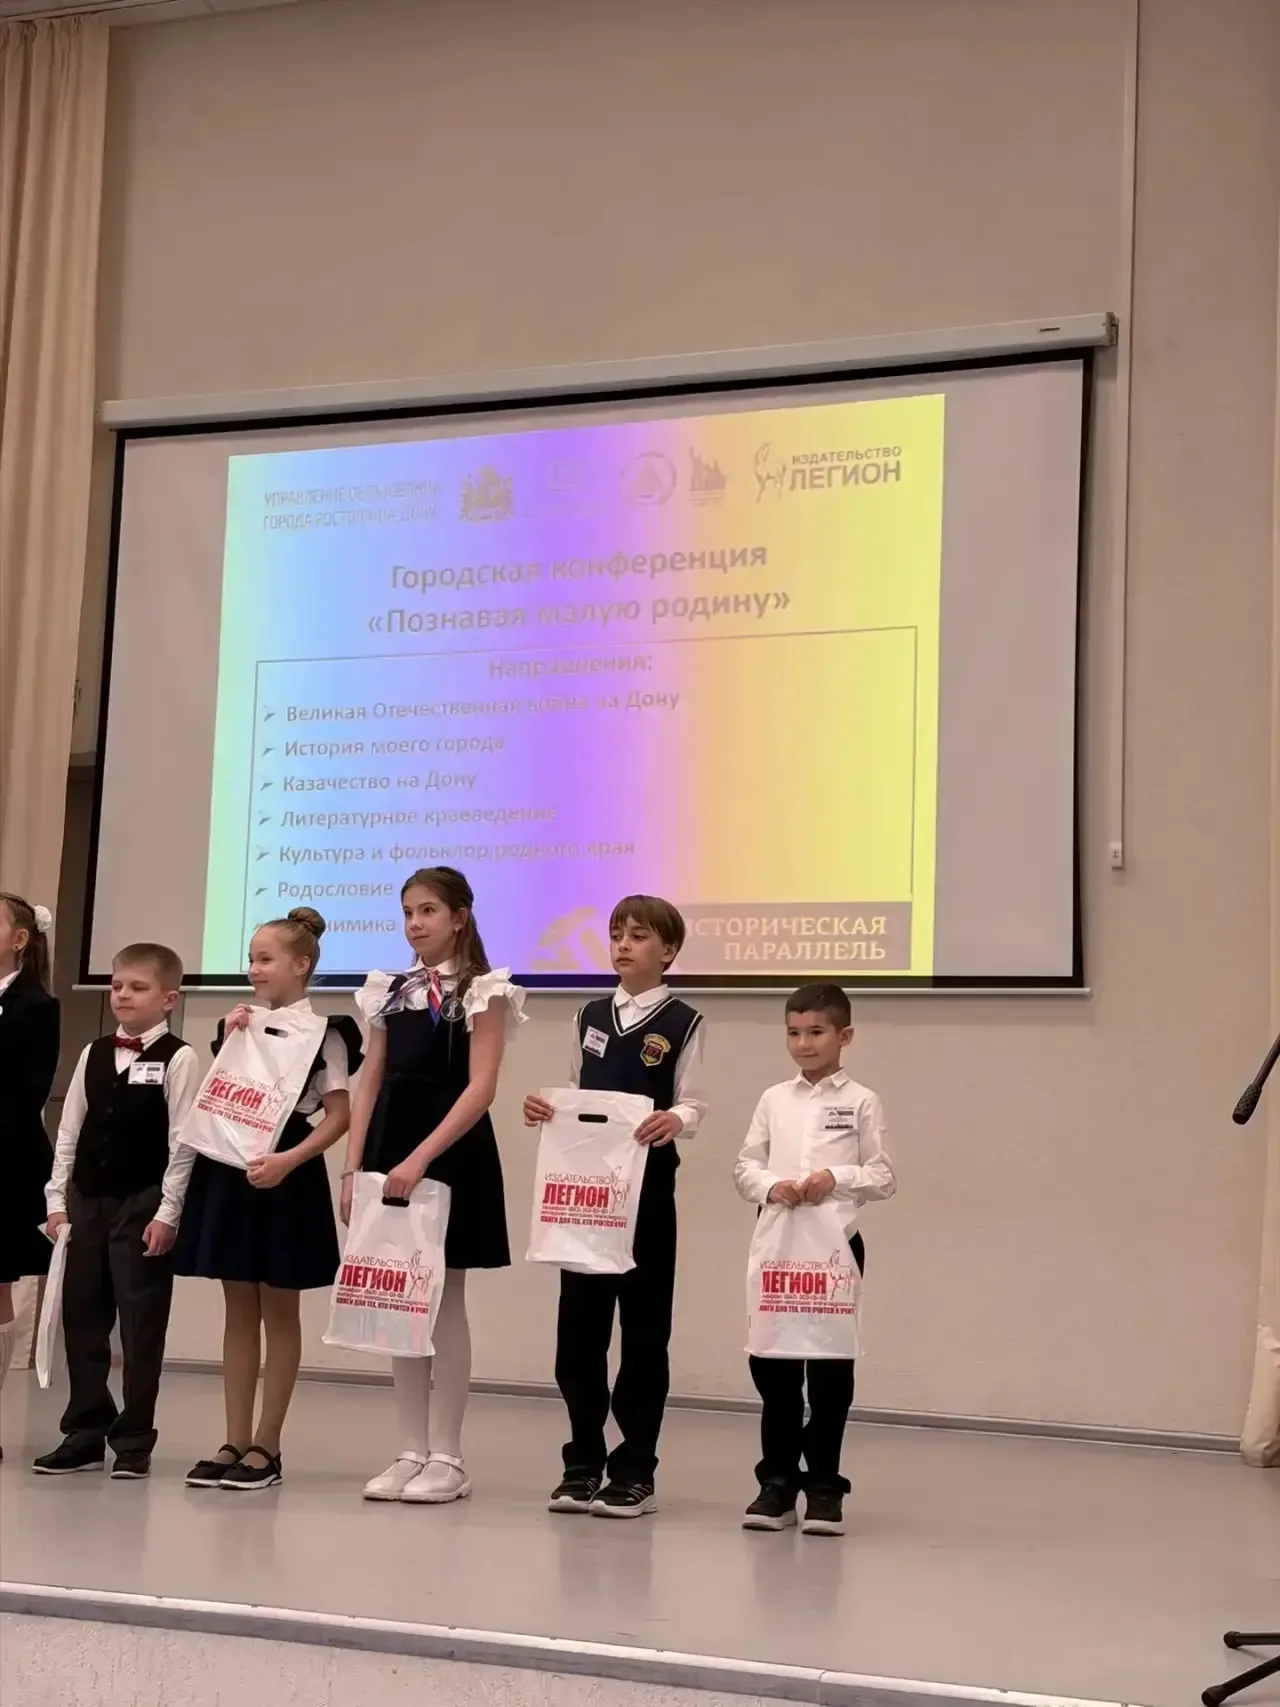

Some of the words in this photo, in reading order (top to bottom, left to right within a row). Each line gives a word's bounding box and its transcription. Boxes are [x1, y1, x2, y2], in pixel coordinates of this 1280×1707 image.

[792, 446, 902, 466] ИЗДАТЕЛЬСТВО
[789, 460, 901, 492] ЛЕГИОН
[263, 511, 311, 532] ГОРОДА
[392, 562, 541, 594] Городская
[552, 545, 768, 580] конференция
[368, 607, 526, 633] «Познавая
[538, 598, 641, 627] малую
[652, 591, 791, 624] родину»
[489, 655, 653, 679] Направления:
[287, 705, 366, 722] Великая
[373, 699, 520, 719] Отечественная
[625, 690, 680, 712] Дону
[284, 740, 364, 759] История
[372, 738, 430, 755] моего
[437, 734, 504, 755] города
[283, 775, 391, 793] Казачество
[397, 775, 419, 790] на
[425, 770, 476, 791] Дону
[280, 810, 418, 829] Литературное
[424, 807, 557, 827] краеведение
[279, 846, 365, 865] Культура
[371, 846, 384, 861] и
[389, 843, 488, 863] фольклор
[494, 842, 580, 862] родного
[586, 841, 635, 862] края
[278, 881, 393, 900] Родословие
[724, 941, 886, 961] ПАРАЛЛЕЛЬ
[205, 1077, 266, 1110] ЛЕГИОН
[545, 1172, 611, 1185] ИЗДАТЕЛЬСТВО
[543, 1183, 609, 1208] ЛЕГИОН
[760, 1260, 829, 1271] ИЗДАТЕЛЬСТВО
[339, 1264, 407, 1292] ЛЕГИОН
[762, 1271, 827, 1294] ЛЕГИОН
